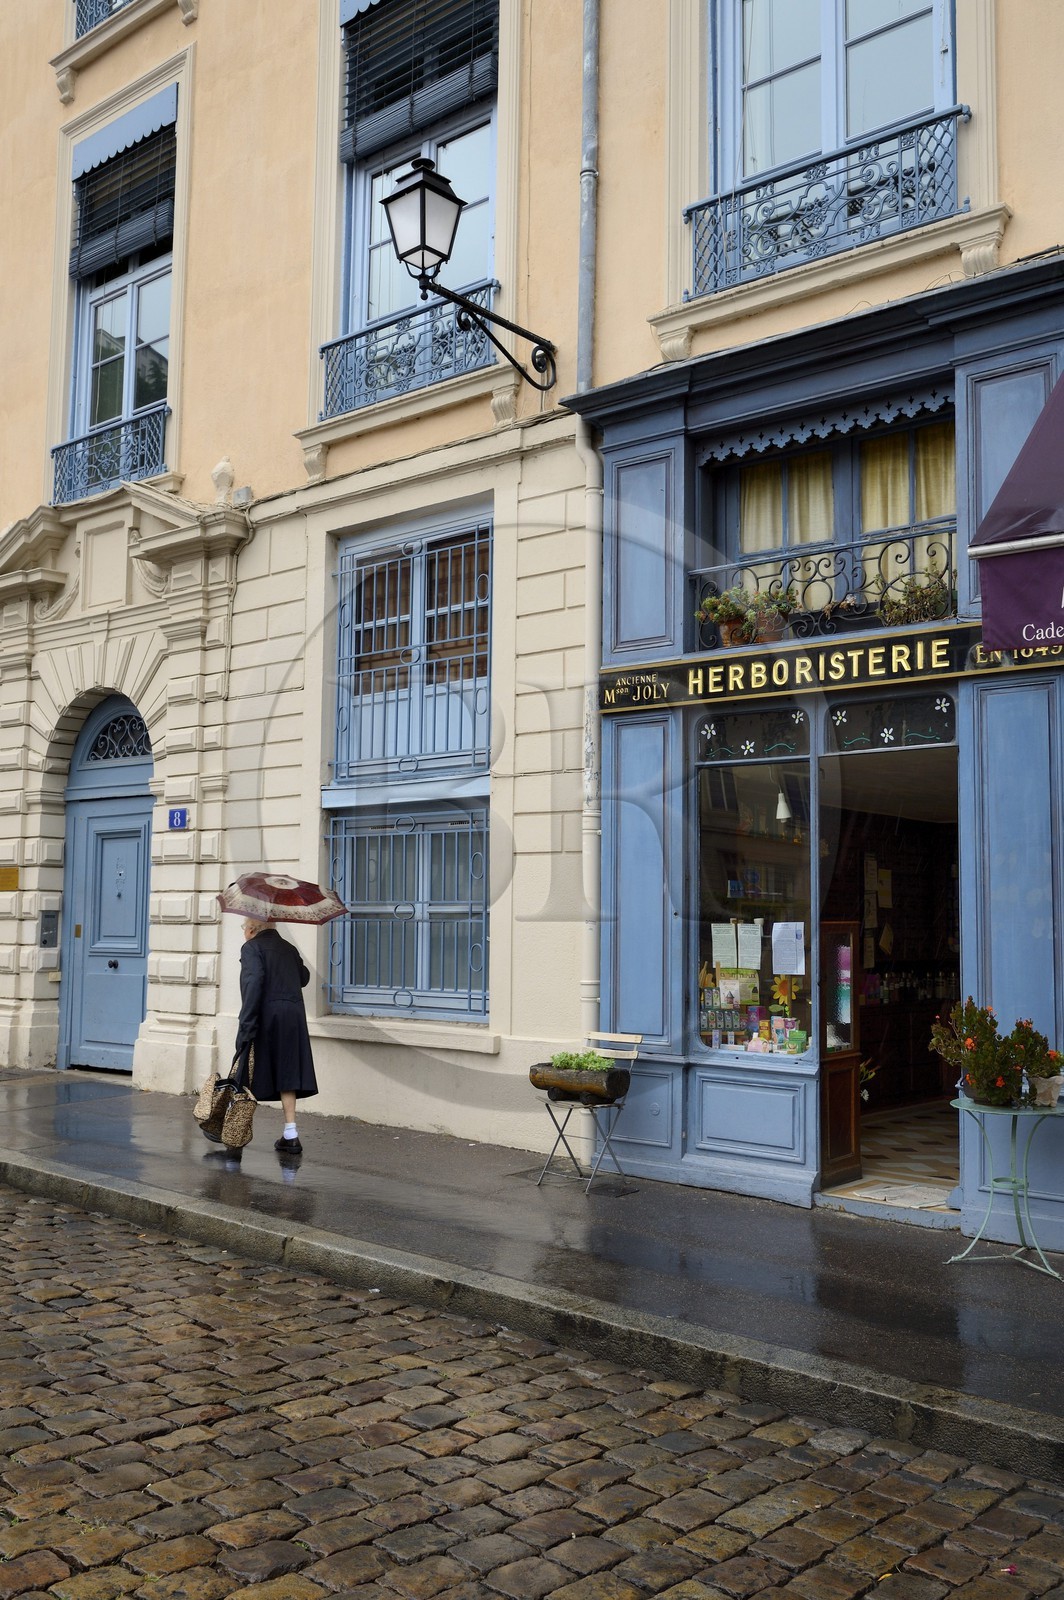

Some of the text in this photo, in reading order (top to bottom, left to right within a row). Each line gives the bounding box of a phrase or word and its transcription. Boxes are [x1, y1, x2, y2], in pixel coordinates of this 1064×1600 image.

[1022, 621, 1064, 642] Cade
[687, 638, 950, 696] HERBORISTERIE
[615, 673, 657, 687] ANCIENNE
[632, 682, 670, 701] JOLY
[173, 811, 181, 827] 8
